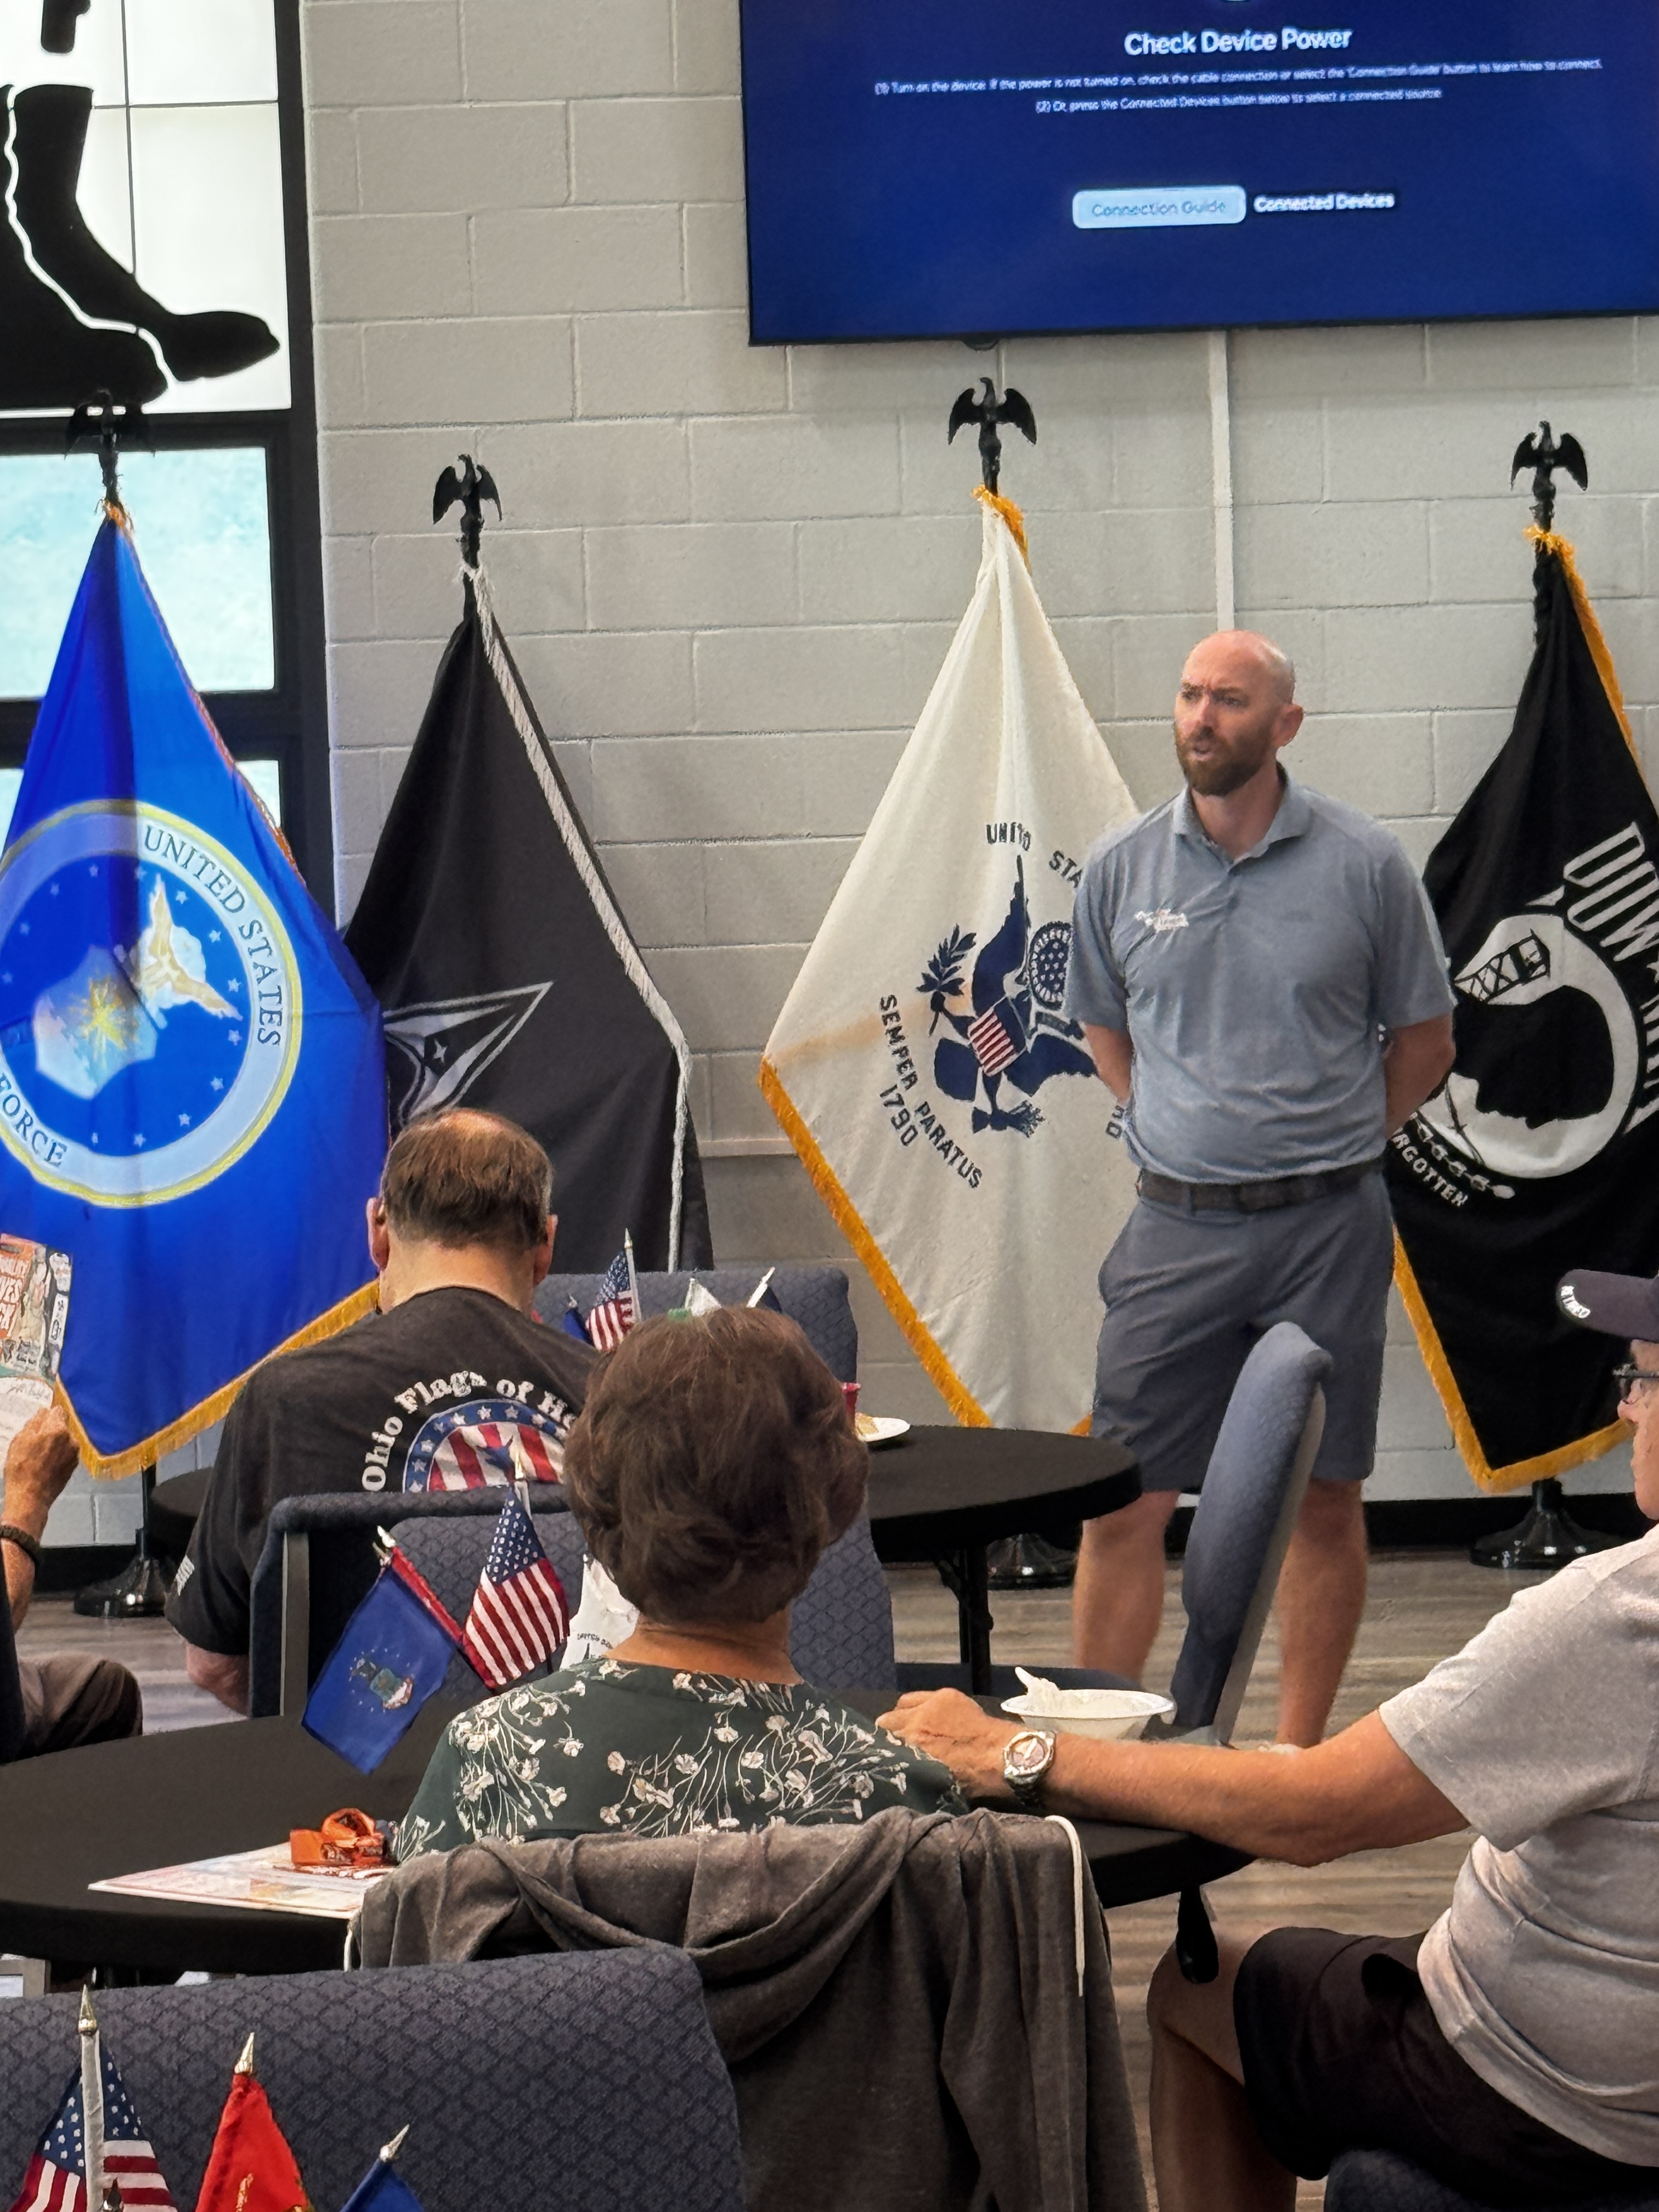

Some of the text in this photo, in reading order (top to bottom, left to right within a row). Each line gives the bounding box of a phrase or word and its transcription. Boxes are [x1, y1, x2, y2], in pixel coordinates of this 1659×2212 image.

[1124, 26, 1353, 55] Check Device Power
[1092, 199, 1226, 217] Connection Guide
[144, 825, 283, 1046] UNITED STATES
[879, 1084, 918, 1147] 1790
[914, 1101, 983, 1189] PARATUS
[1391, 1130, 1469, 1207] RGOTTEN
[362, 1416, 403, 1492] Ohio
